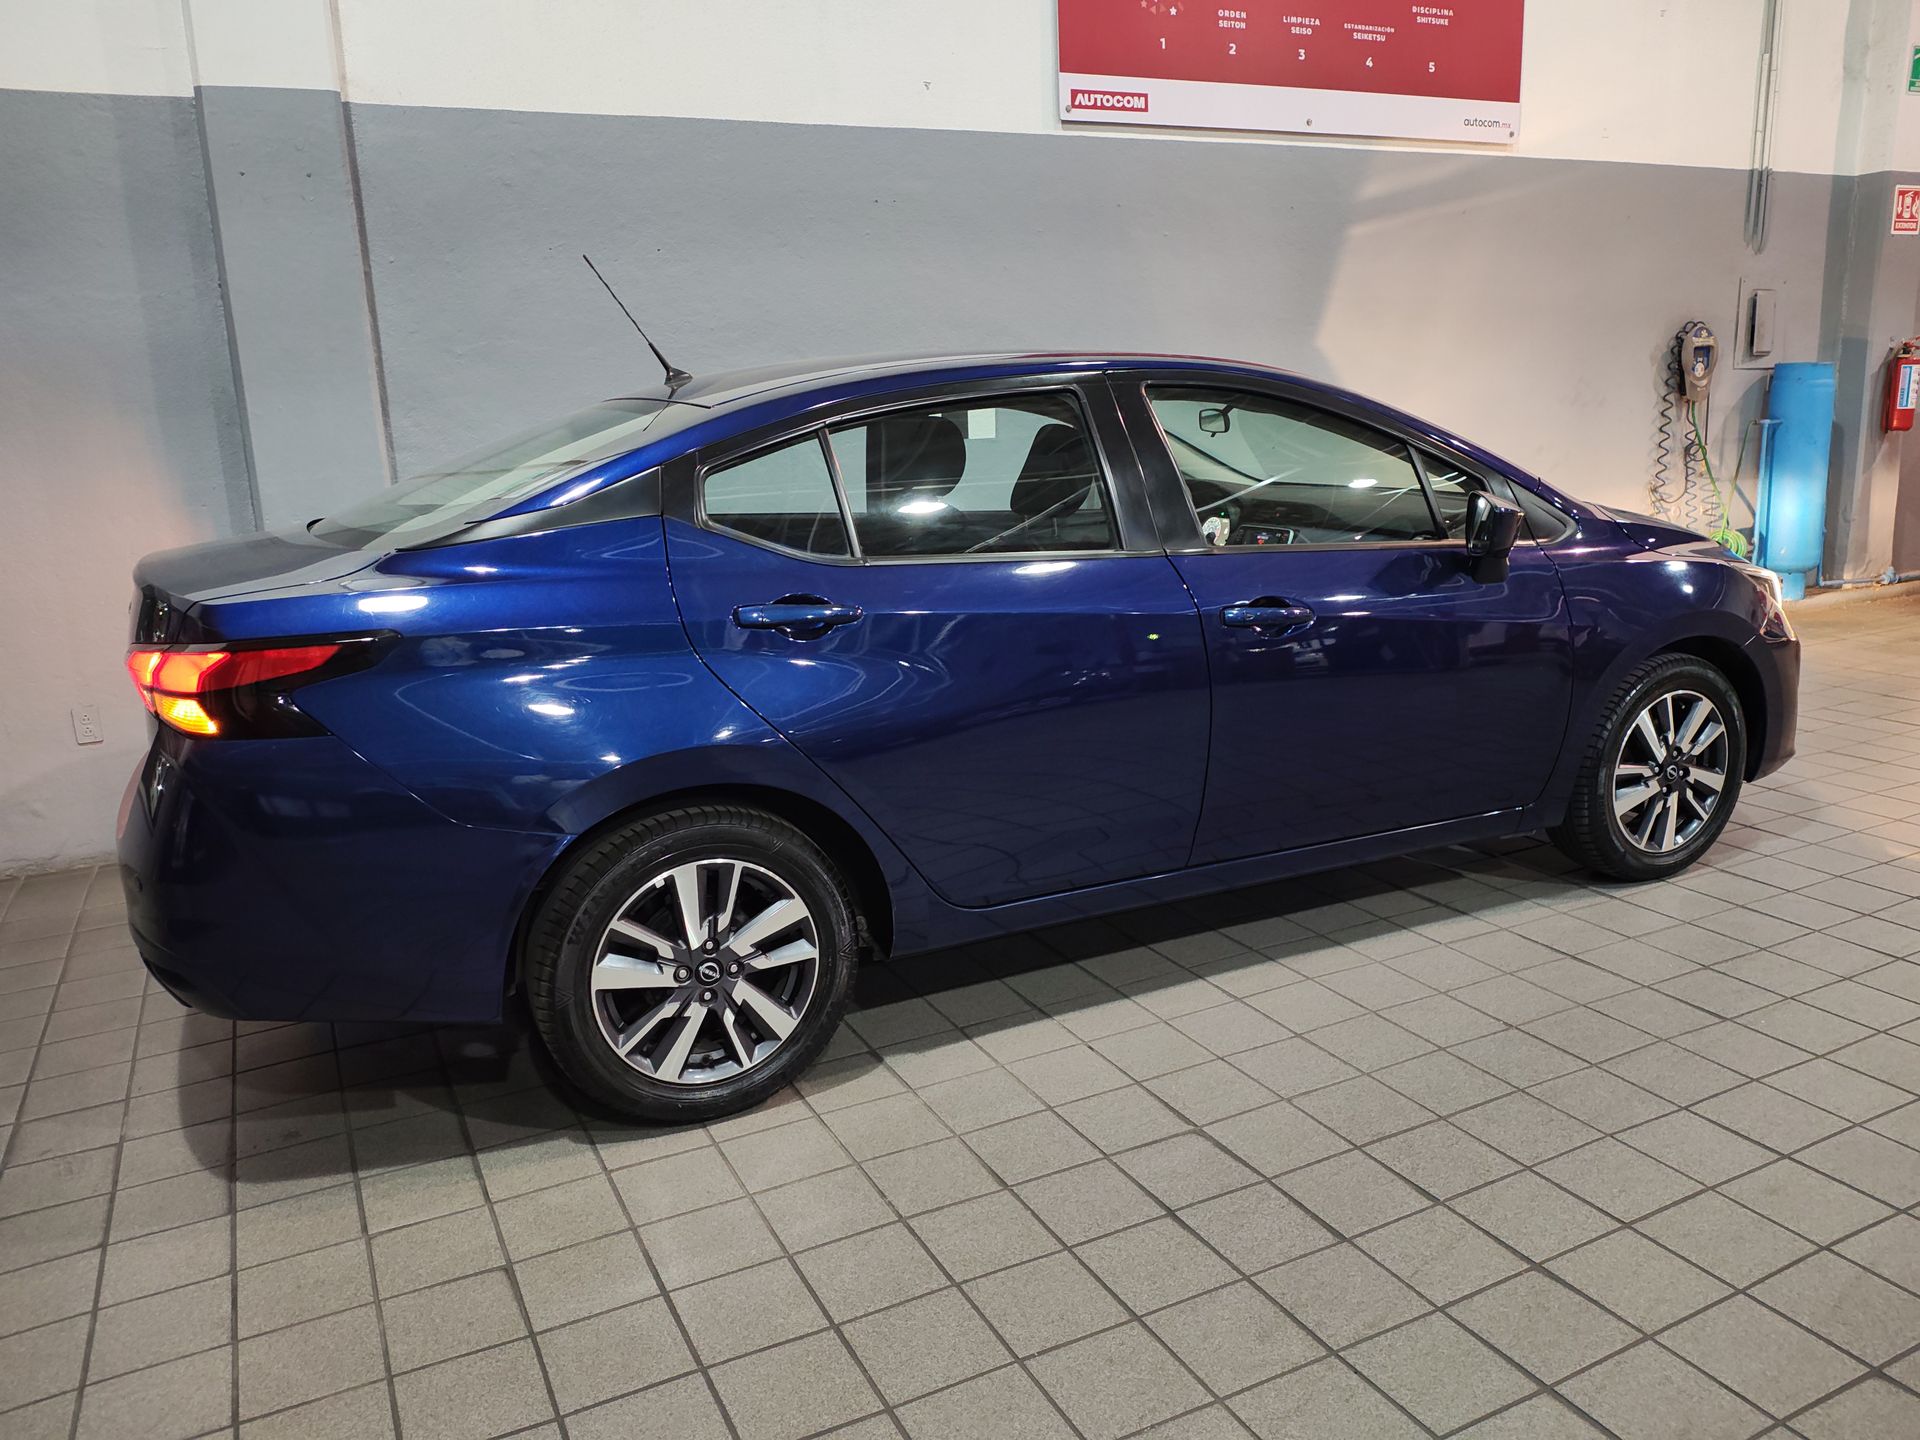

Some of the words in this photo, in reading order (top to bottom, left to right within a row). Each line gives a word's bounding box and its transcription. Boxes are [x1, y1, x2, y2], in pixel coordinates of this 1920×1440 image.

[1217, 9, 1247, 19] ORDEN
[1411, 5, 1454, 16] DISCIPLINA
[1218, 20, 1246, 29] SEITON
[1282, 15, 1321, 26] LIMPIEZA
[1416, 16, 1449, 26] SHITSUKE
[1290, 26, 1313, 35] SEISO
[1343, 22, 1395, 33] ESTANDARIZACIÓN
[1352, 32, 1386, 42] SEIKETSU
[1159, 37, 1166, 50] 1
[1228, 43, 1237, 55] 2
[1298, 48, 1306, 60] 3
[1365, 56, 1374, 68] 4
[1428, 61, 1436, 73] 5
[1074, 92, 1146, 109] AUTOCOM
[1463, 117, 1511, 129] autocom.mx
